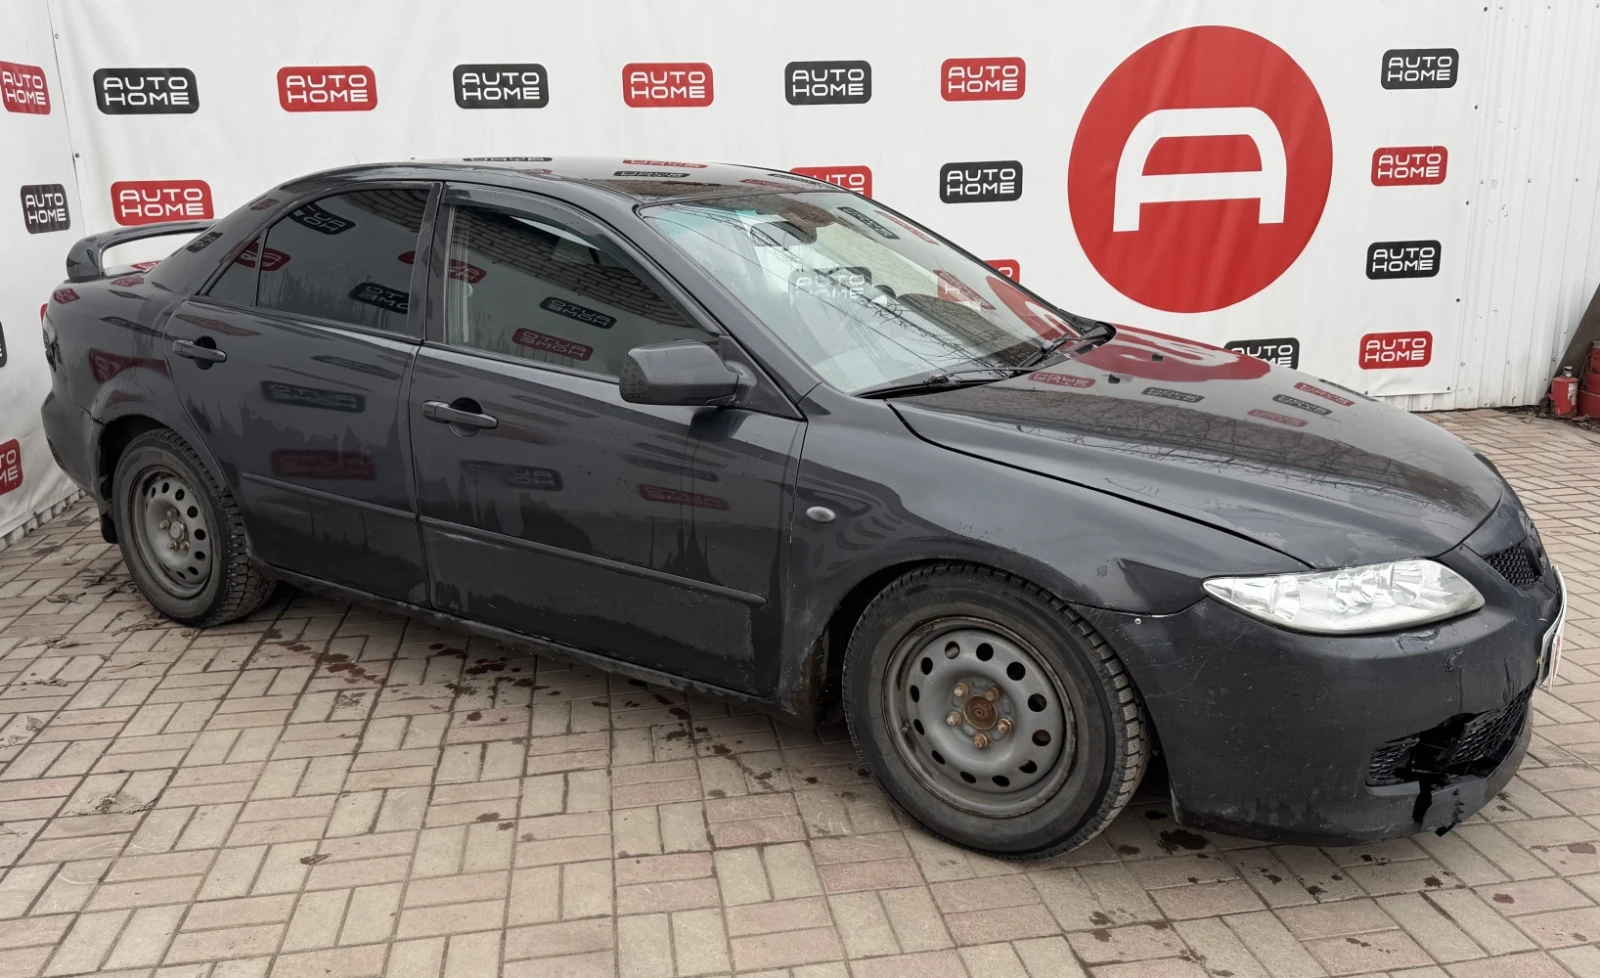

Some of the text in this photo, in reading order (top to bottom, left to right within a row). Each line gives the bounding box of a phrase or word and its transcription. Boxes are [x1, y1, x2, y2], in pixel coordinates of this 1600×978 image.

[1388, 56, 1452, 69] AUTO
[462, 72, 540, 86] AUTO
[630, 71, 705, 84] AUTO
[792, 69, 864, 82] AUTO
[948, 65, 1019, 79] AUTO
[1387, 69, 1451, 82] HOME
[2, 71, 43, 89] AUTO
[103, 76, 188, 90] AUTO
[286, 74, 367, 88] AUTO
[948, 79, 1018, 93] HOME
[5, 88, 46, 105] HOME
[287, 89, 368, 103] HOME
[462, 87, 540, 100] HOME
[631, 86, 705, 99] HOME
[792, 83, 864, 97] HOME
[104, 92, 190, 106] HOME
[1378, 153, 1441, 166] AUTO
[947, 168, 1016, 182] AUTO
[1113, 106, 1287, 232] A
[1377, 166, 1440, 179] HOME
[119, 188, 203, 202] AUTO
[946, 182, 1015, 196] HOME
[25, 193, 64, 208] AUTO
[27, 208, 66, 224] HOME
[121, 203, 204, 217] HOME
[1373, 247, 1435, 260] AUTO
[1372, 259, 1434, 272] HOME
[1366, 338, 1426, 350] AUTO
[1365, 350, 1425, 362] HOME
